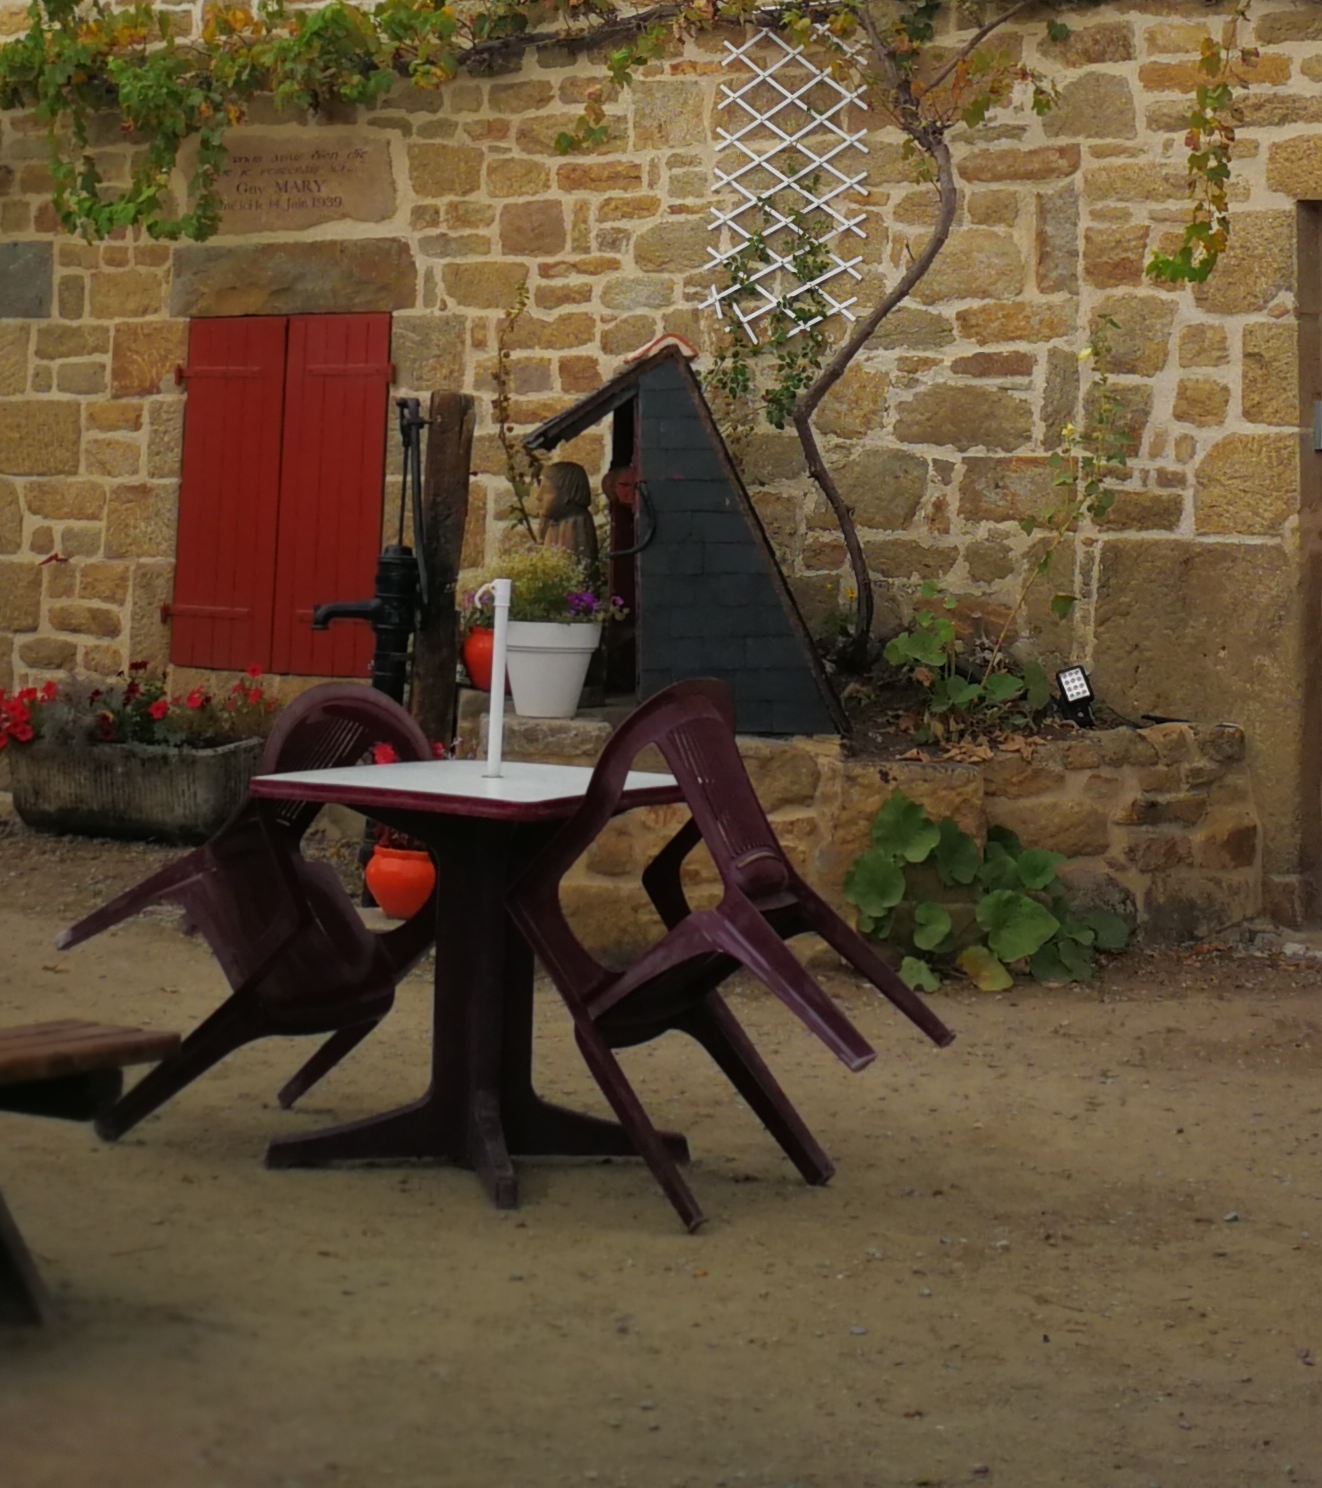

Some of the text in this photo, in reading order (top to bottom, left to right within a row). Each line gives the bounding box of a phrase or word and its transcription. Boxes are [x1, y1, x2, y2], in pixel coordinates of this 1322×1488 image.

[236, 179, 326, 198] Guy MARY
[311, 195, 343, 209] 1939
